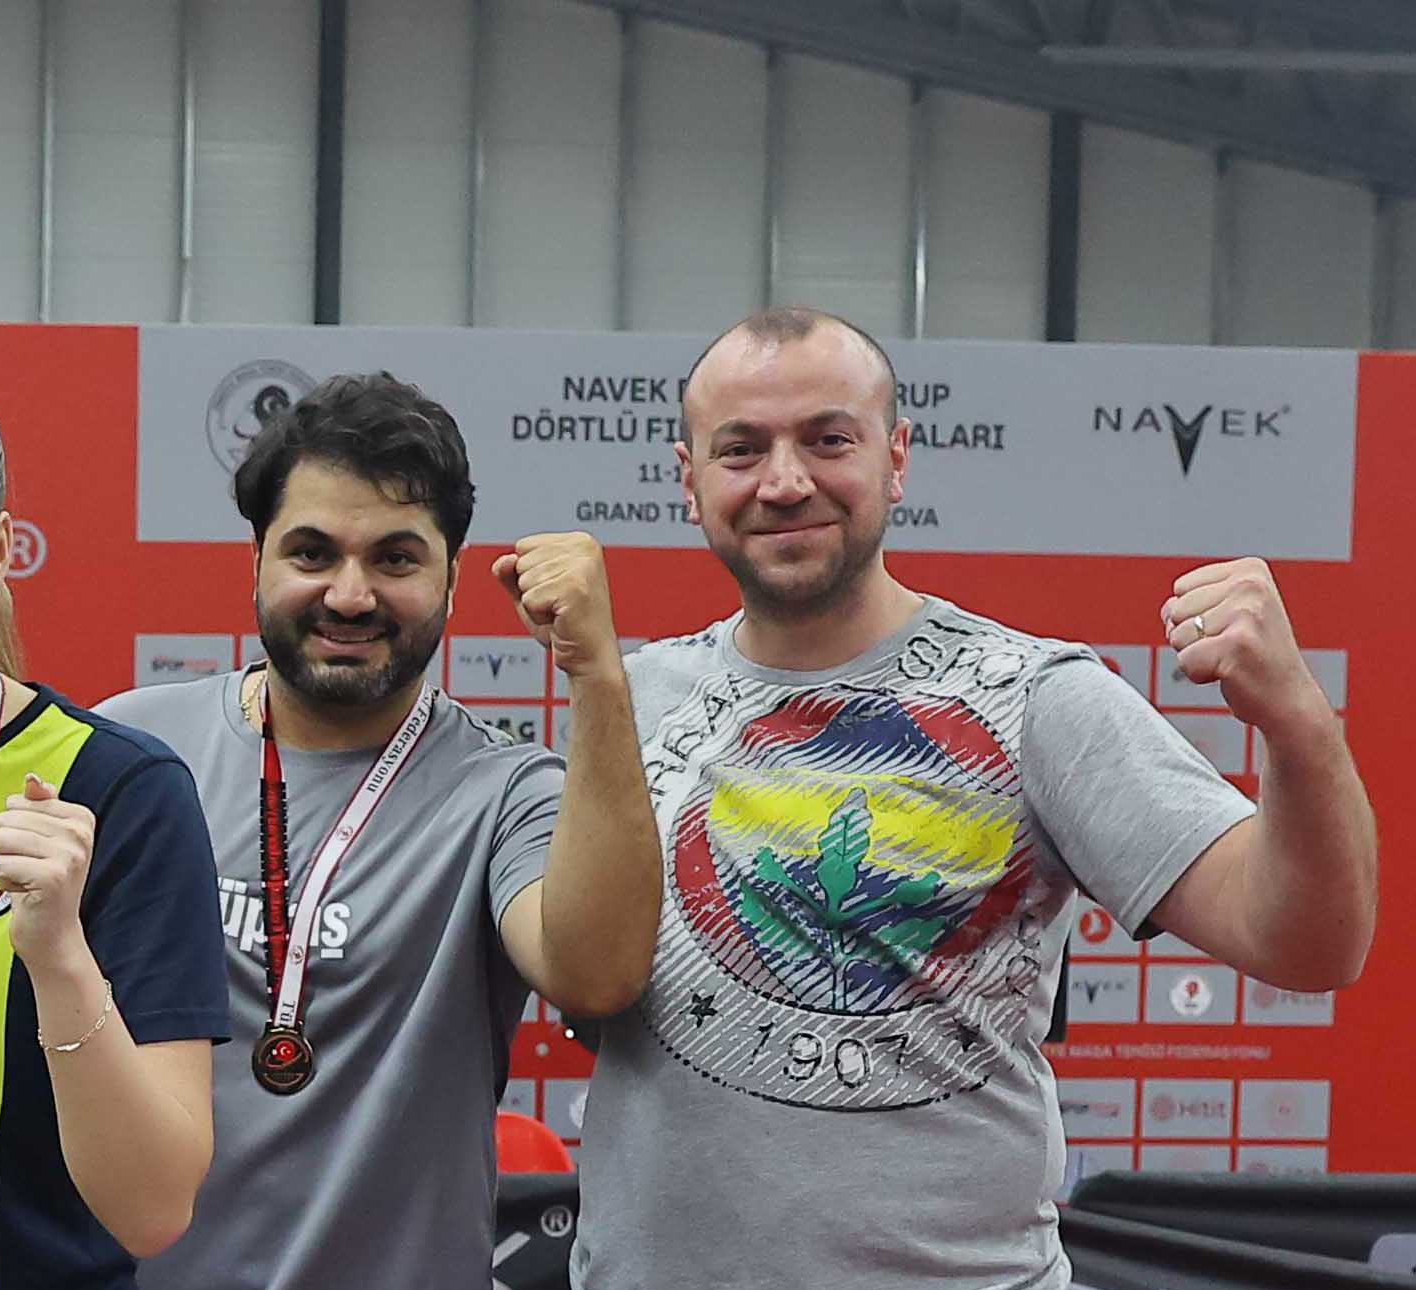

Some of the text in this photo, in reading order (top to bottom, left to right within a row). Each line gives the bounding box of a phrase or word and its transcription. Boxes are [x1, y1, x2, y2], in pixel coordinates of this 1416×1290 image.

[563, 376, 668, 403] NAVEK
[512, 408, 637, 442] DÖRTLÜ
[1094, 404, 1282, 477] NAVEK
[576, 502, 660, 522] GRAND
[366, 705, 429, 794] Federasyonu
[746, 1020, 912, 1088] 1907
